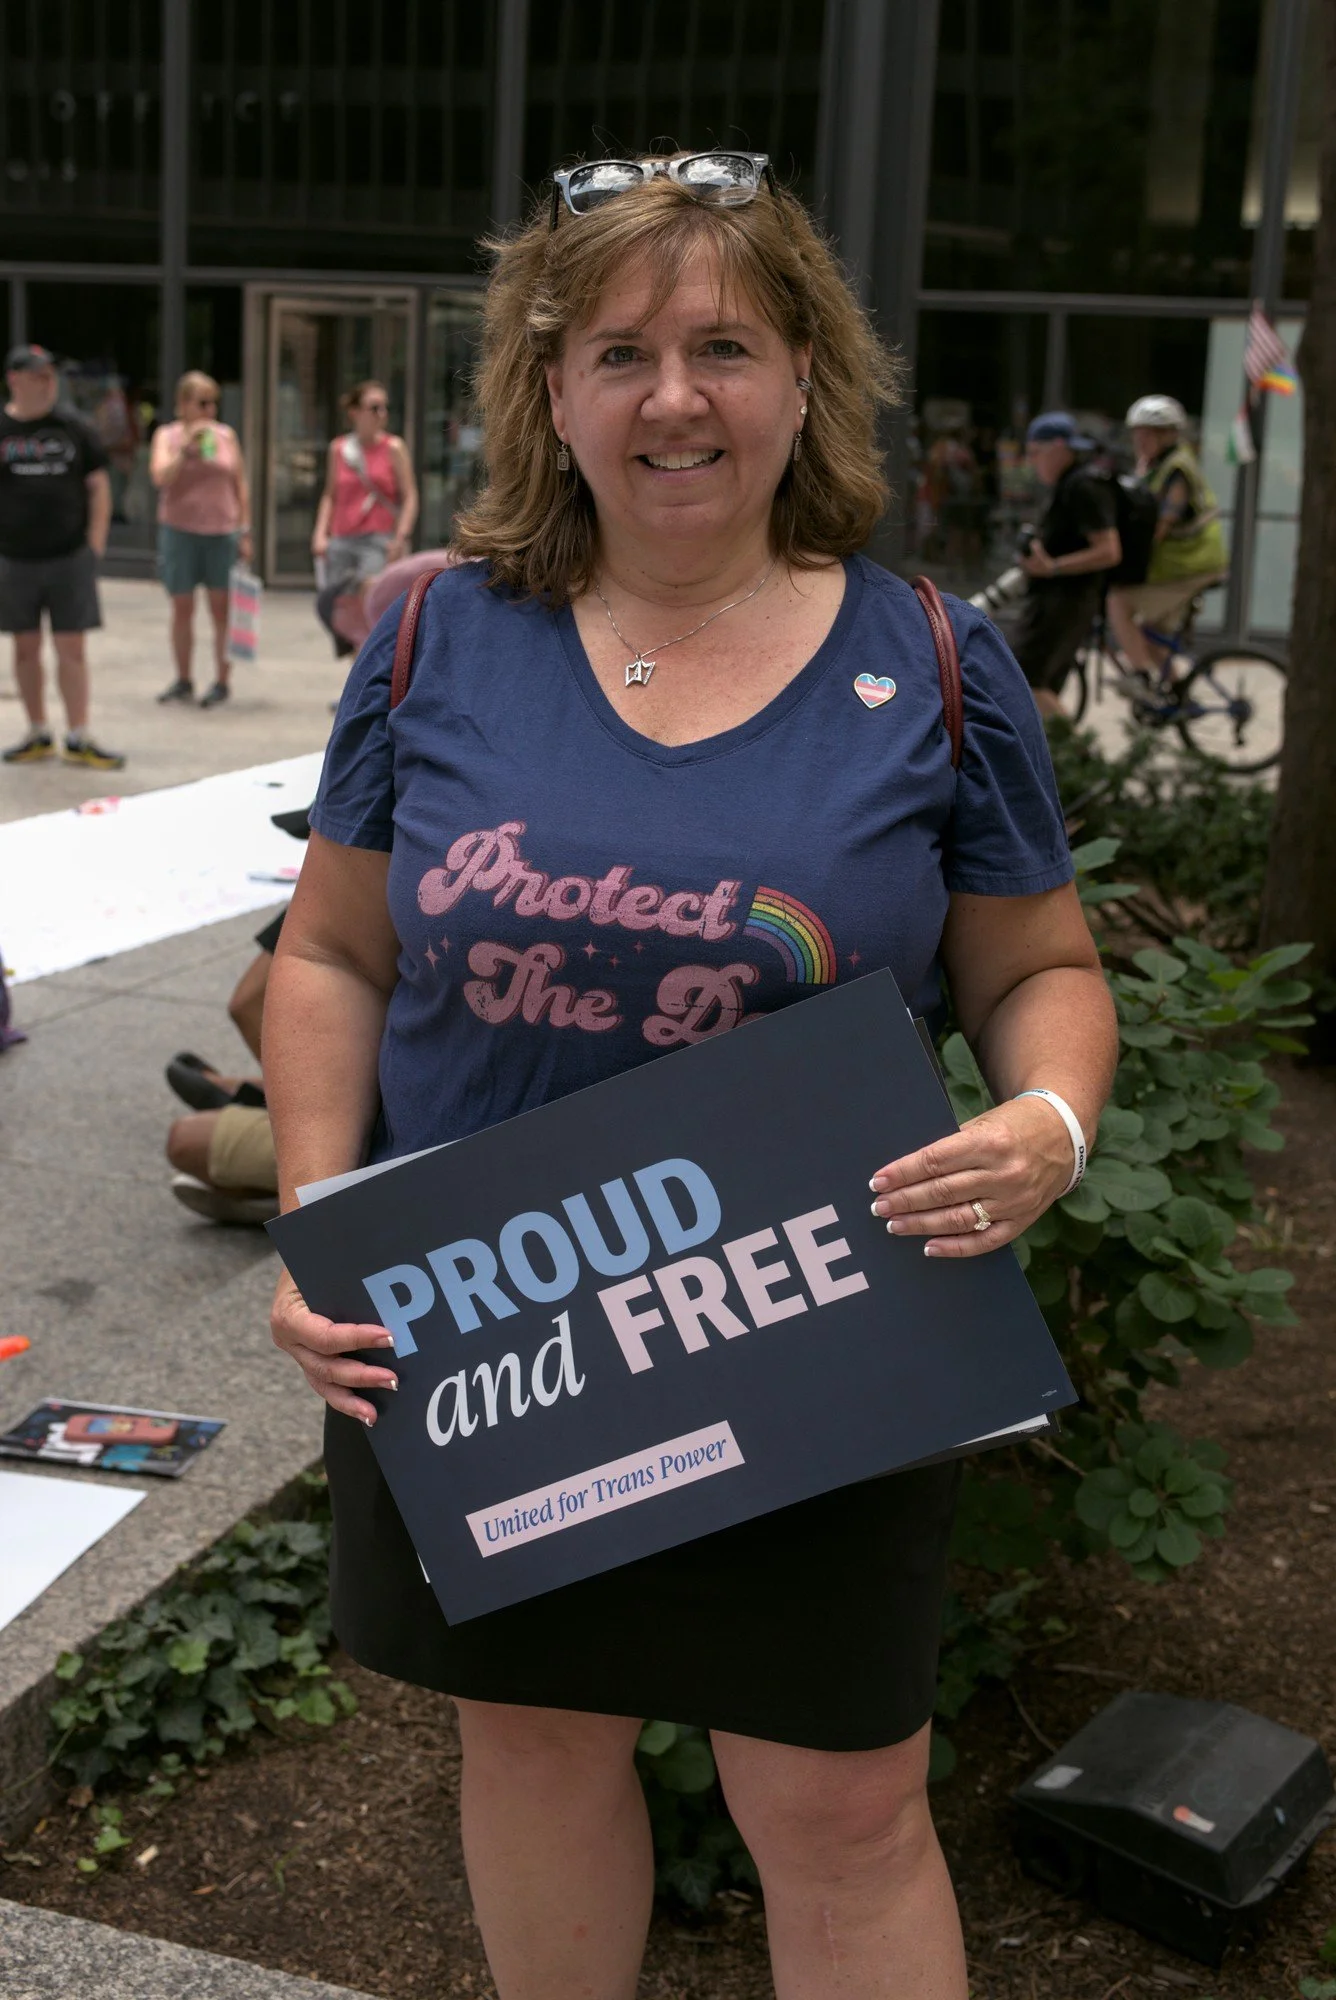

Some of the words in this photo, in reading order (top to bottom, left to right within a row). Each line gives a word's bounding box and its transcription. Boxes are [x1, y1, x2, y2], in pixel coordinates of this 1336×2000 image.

[416, 820, 743, 942] Protect
[463, 940, 624, 1033] The
[362, 1158, 722, 1358] PROUD
[426, 1310, 586, 1447] and
[596, 1204, 870, 1375] FREE
[483, 1498, 554, 1542] United
[556, 1488, 588, 1521] for
[591, 1465, 655, 1503] Trans
[658, 1438, 727, 1480] Power
